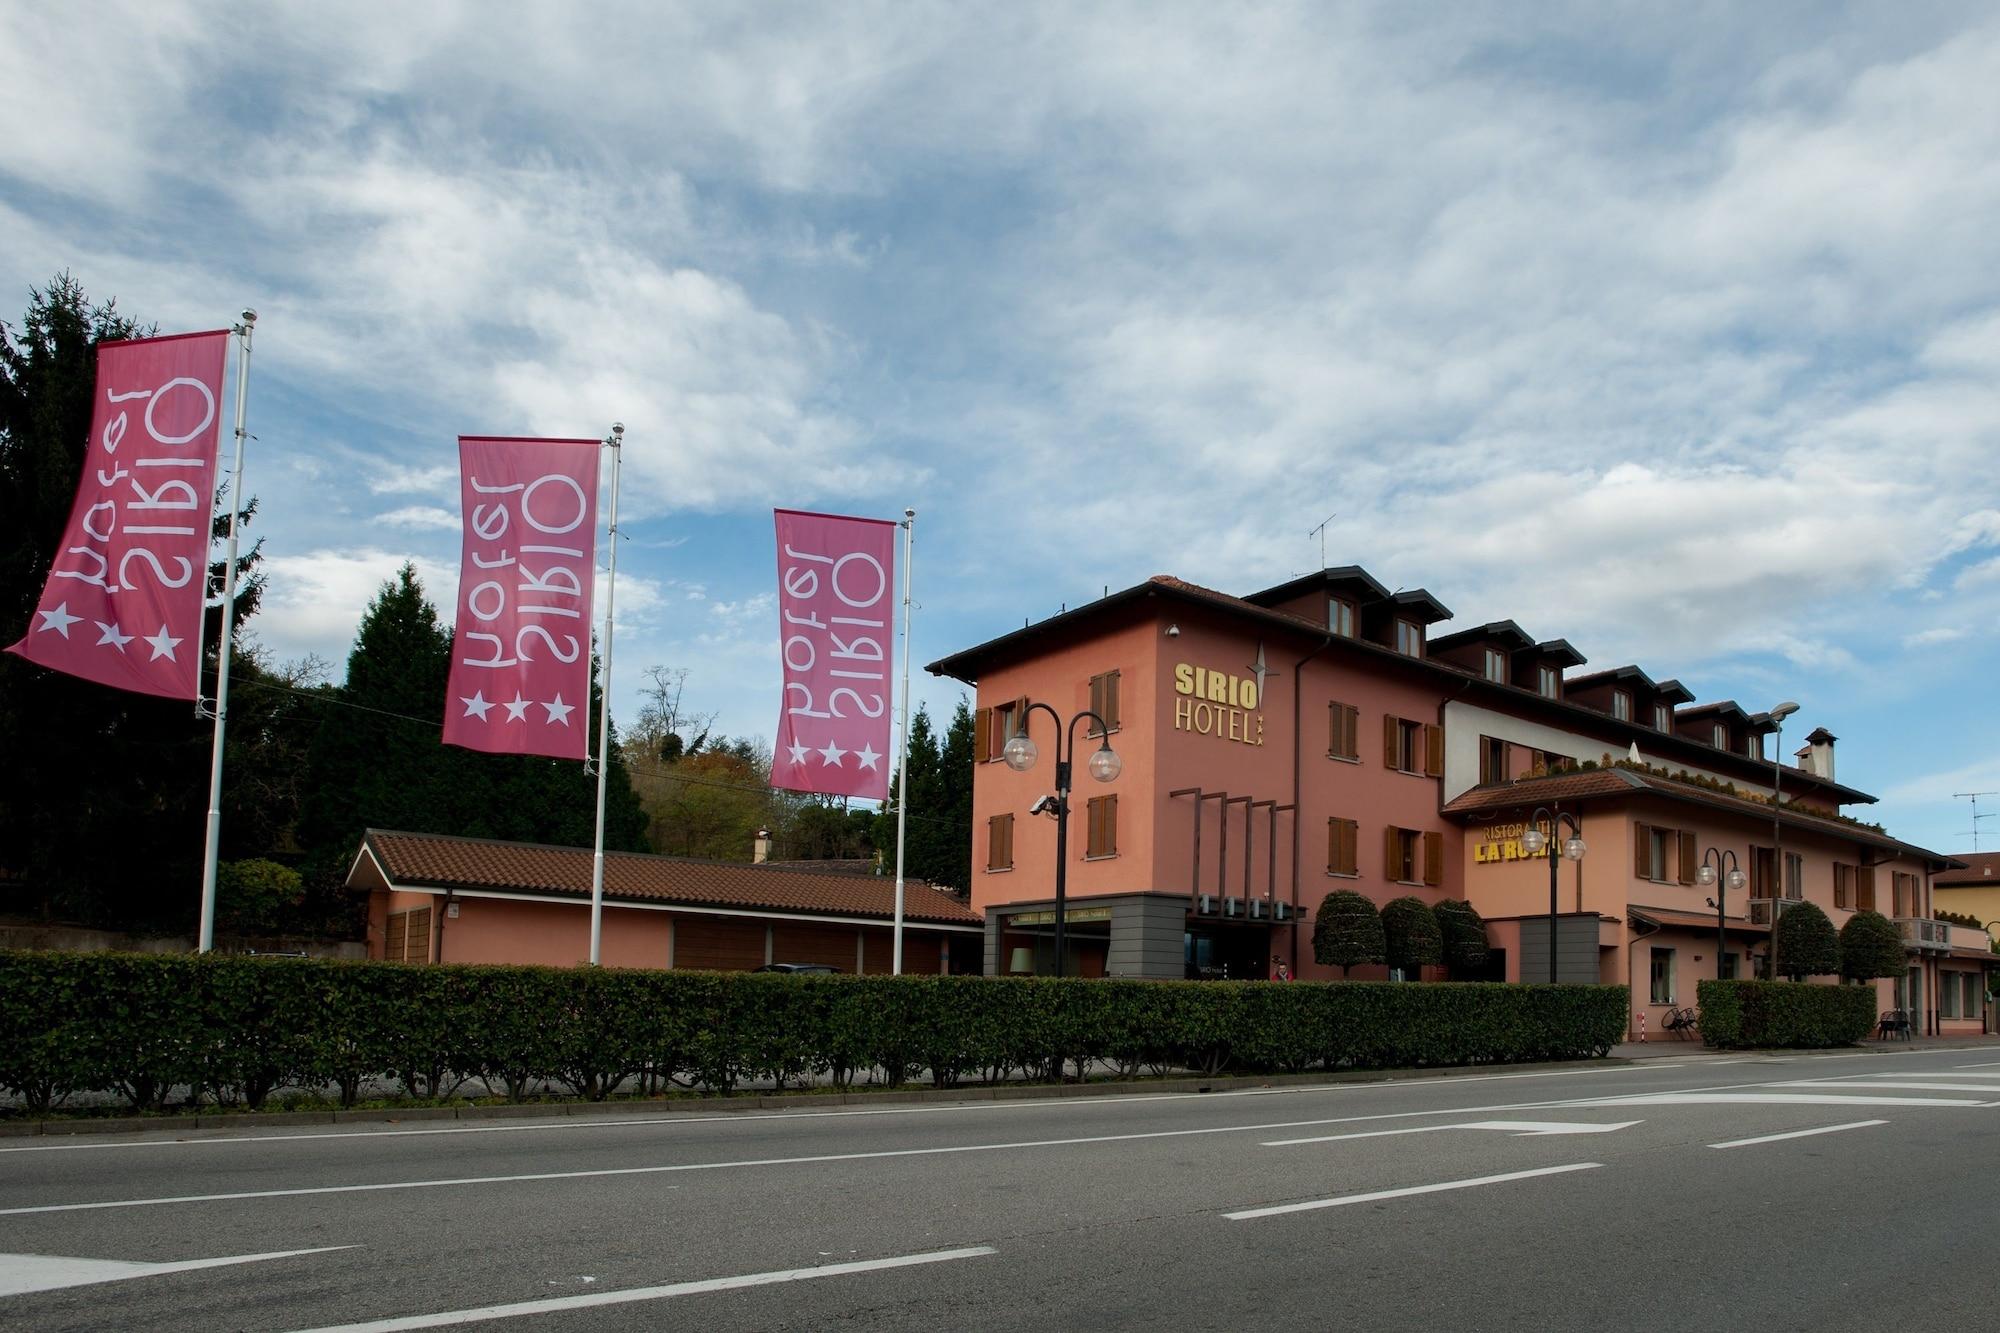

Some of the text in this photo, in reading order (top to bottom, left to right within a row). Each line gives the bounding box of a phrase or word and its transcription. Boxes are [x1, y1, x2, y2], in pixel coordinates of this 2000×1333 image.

[1175, 663, 1257, 710] SIRIO
[1175, 697, 1255, 745] HOTEL
[1474, 841, 1500, 862] LA
